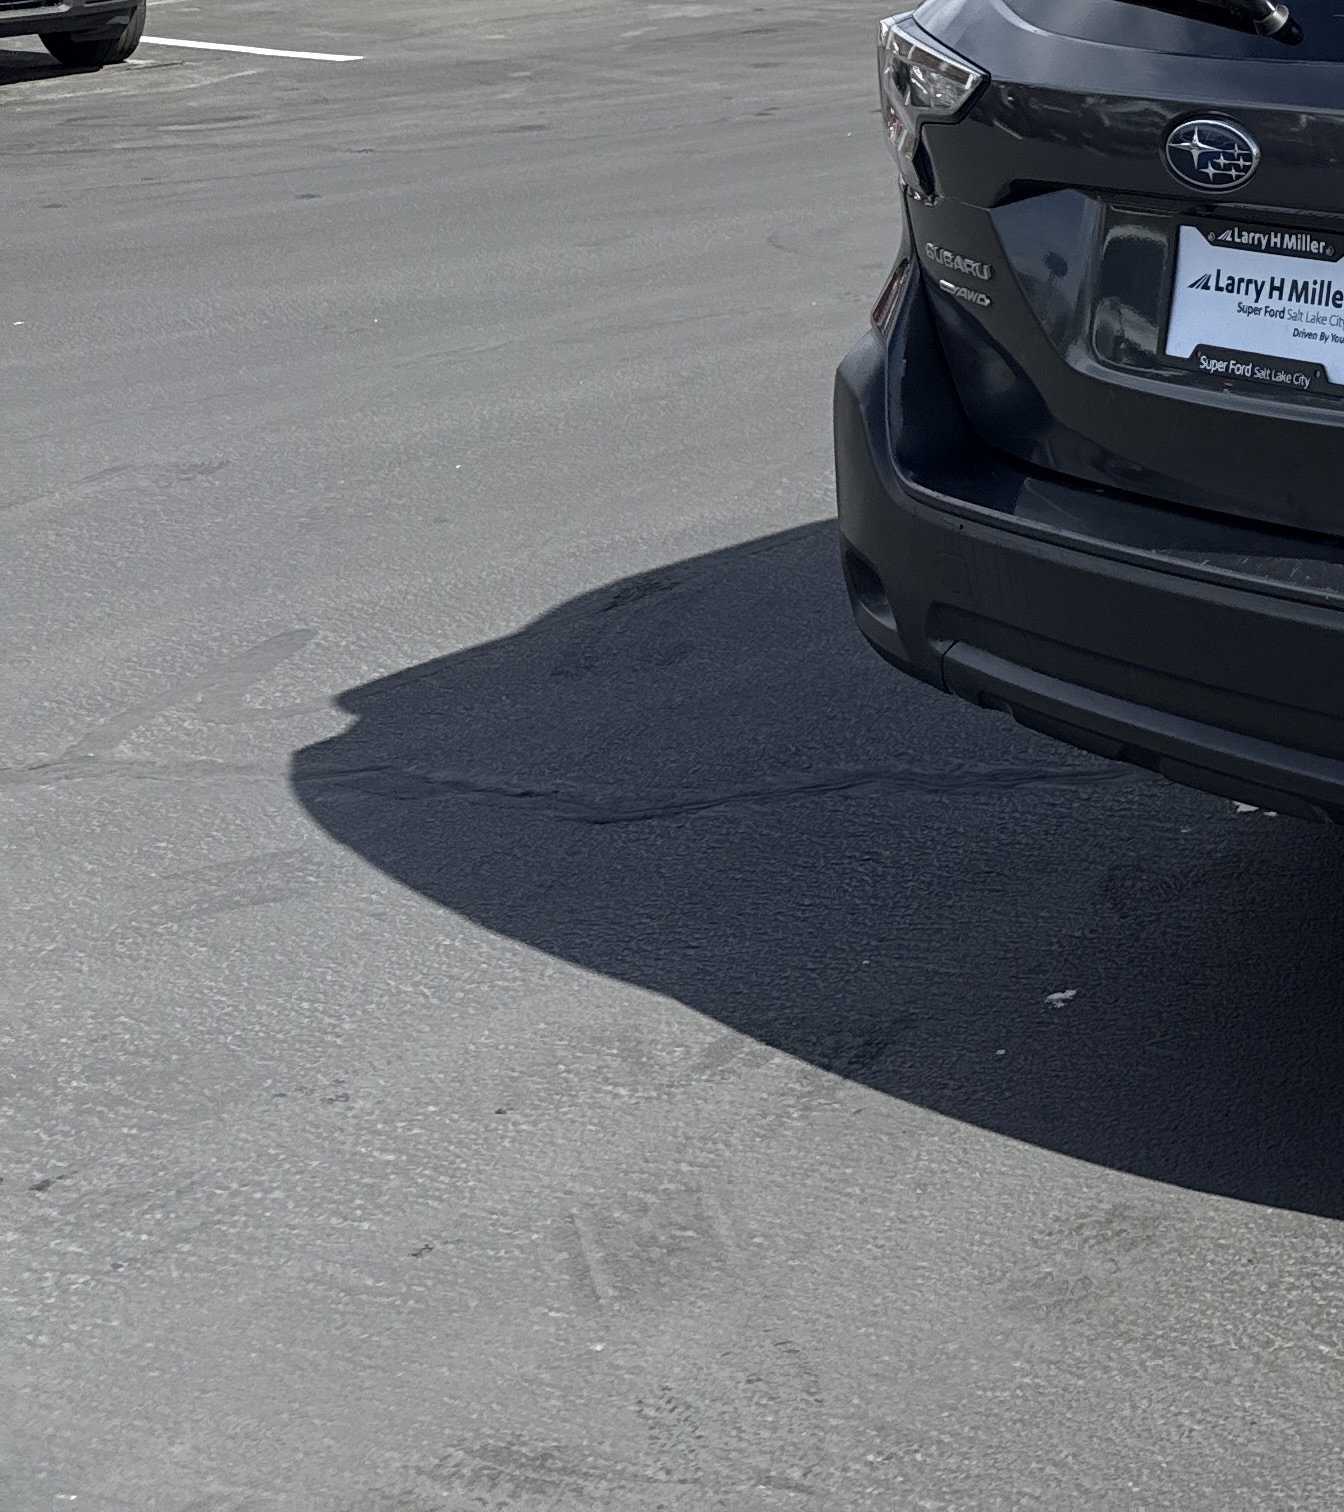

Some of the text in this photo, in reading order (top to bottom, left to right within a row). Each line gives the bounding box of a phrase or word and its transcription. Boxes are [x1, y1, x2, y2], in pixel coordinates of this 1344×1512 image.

[1233, 227, 1326, 255] Larry H Miller
[925, 242, 992, 281] SUBARU
[1214, 268, 1266, 304] Larry
[1268, 276, 1286, 301] H
[1237, 301, 1263, 318] Super
[1264, 306, 1286, 319] Ford
[1287, 308, 1304, 323] Salt
[1305, 311, 1328, 326] Lake
[1292, 328, 1318, 341] Driven
[1319, 332, 1331, 345] By
[1200, 355, 1312, 390] Super Ford Salt Lake City
